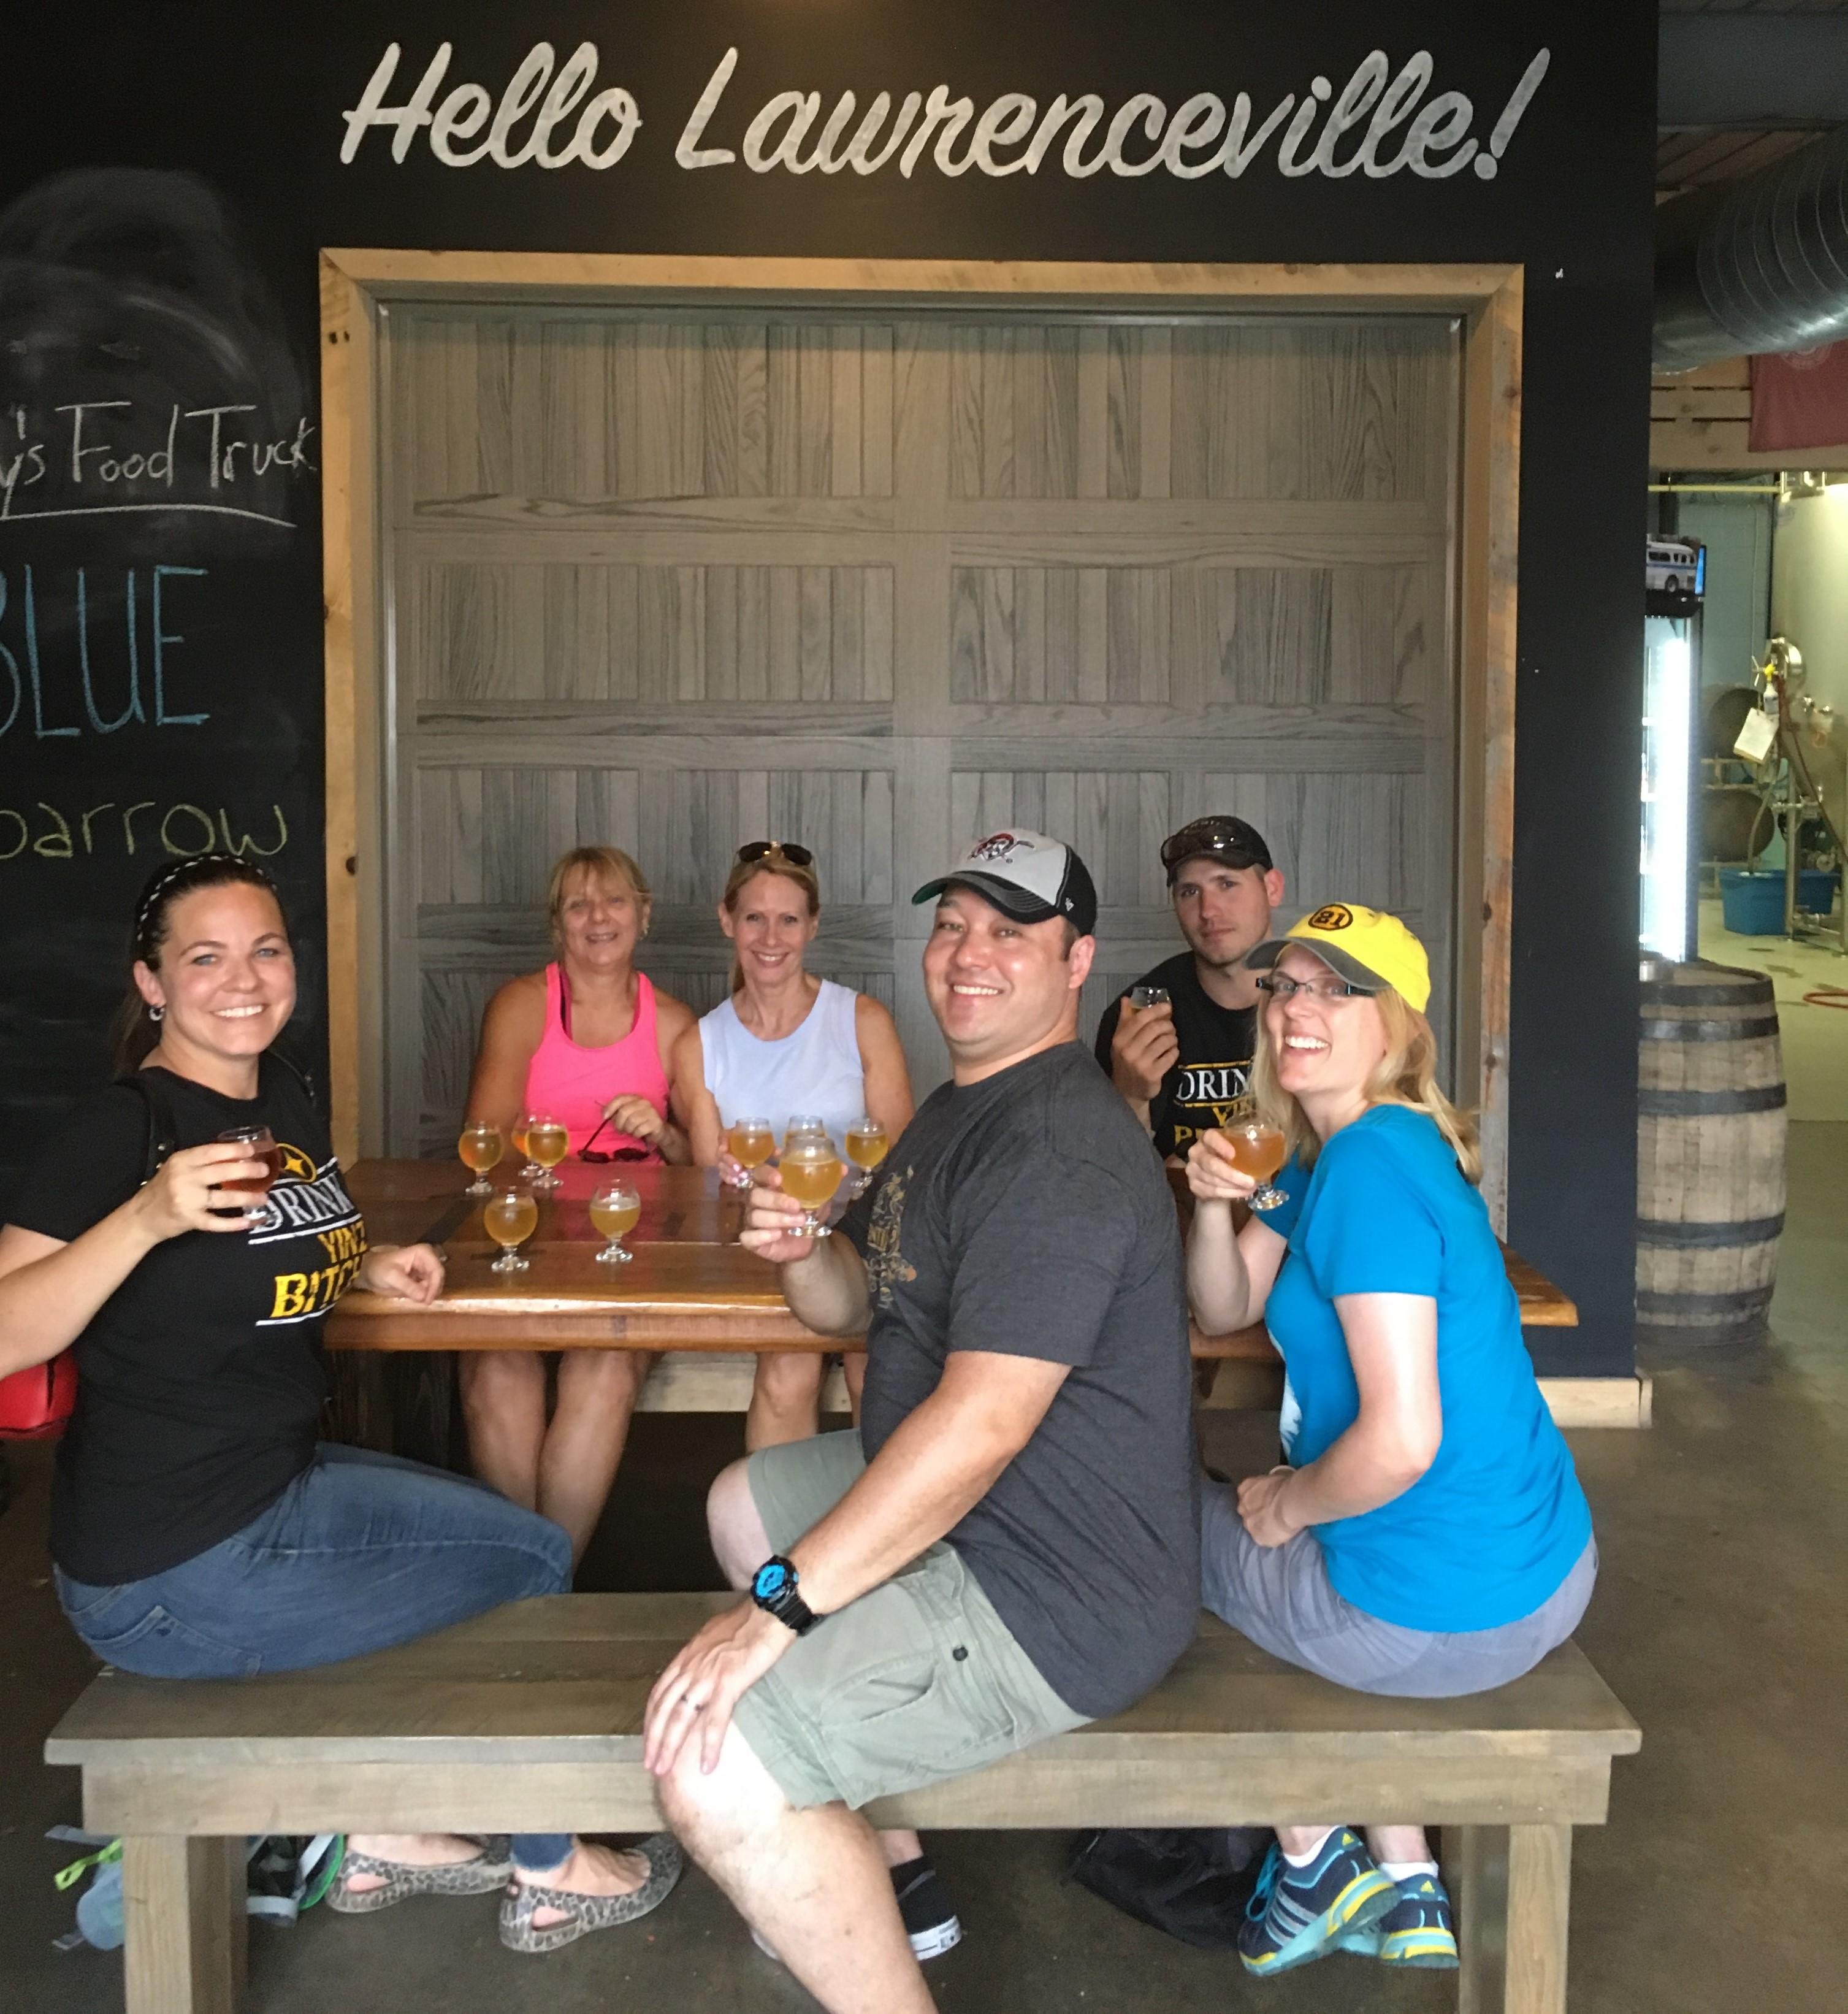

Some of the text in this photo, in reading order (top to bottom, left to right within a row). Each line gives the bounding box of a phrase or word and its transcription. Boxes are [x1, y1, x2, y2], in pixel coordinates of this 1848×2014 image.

[340, 42, 1550, 179] Hello Lawrenceville!
[55, 400, 178, 488] Food
[185, 405, 317, 489] Truck
[1176, 1068, 1250, 1100] DRIN
